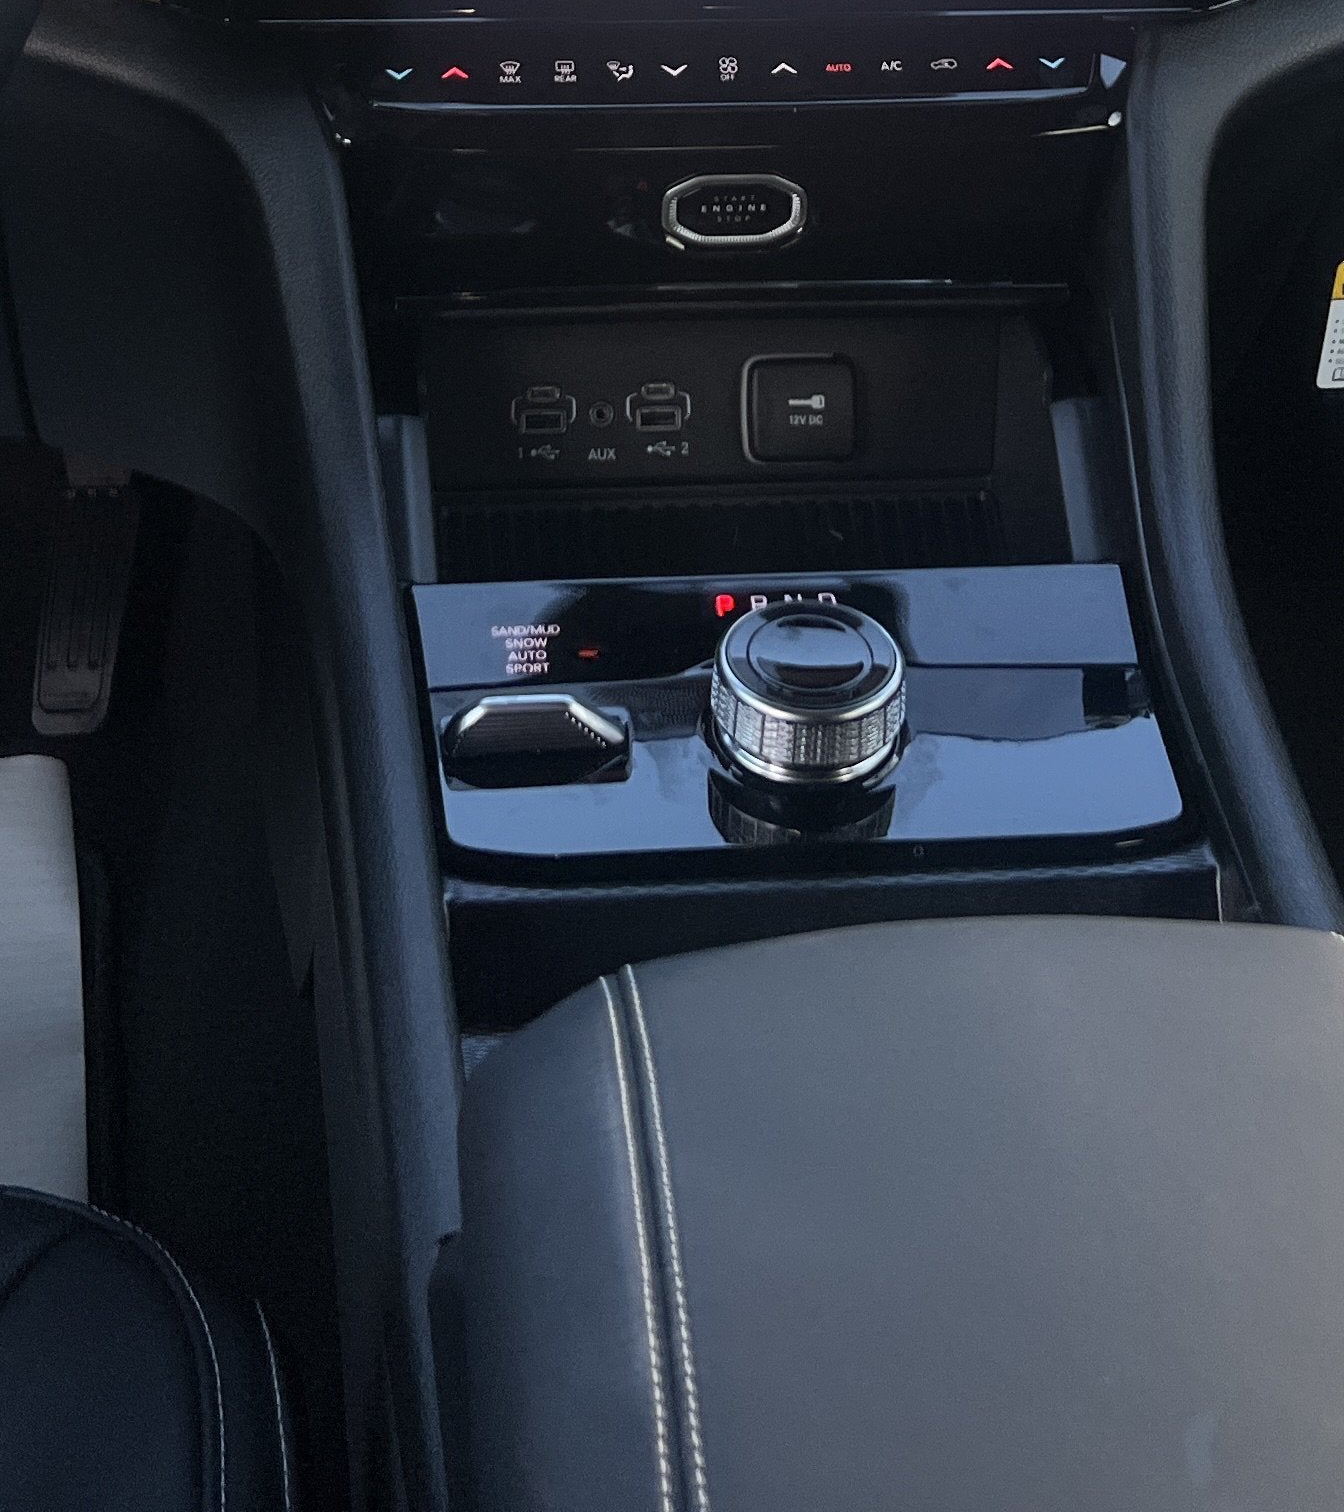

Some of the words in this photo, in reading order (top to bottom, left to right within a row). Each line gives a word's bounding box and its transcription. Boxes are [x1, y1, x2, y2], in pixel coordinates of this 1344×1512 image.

[825, 63, 852, 72] AUTO
[881, 60, 903, 71] A/C
[701, 204, 767, 213] ENGINE
[588, 448, 616, 461] AUX
[681, 442, 689, 455] 2
[715, 593, 735, 617] P
[491, 623, 560, 636] SAND/MUD
[505, 637, 548, 649] SNOW
[508, 649, 547, 661] AUTO
[506, 662, 549, 674] SPORT
